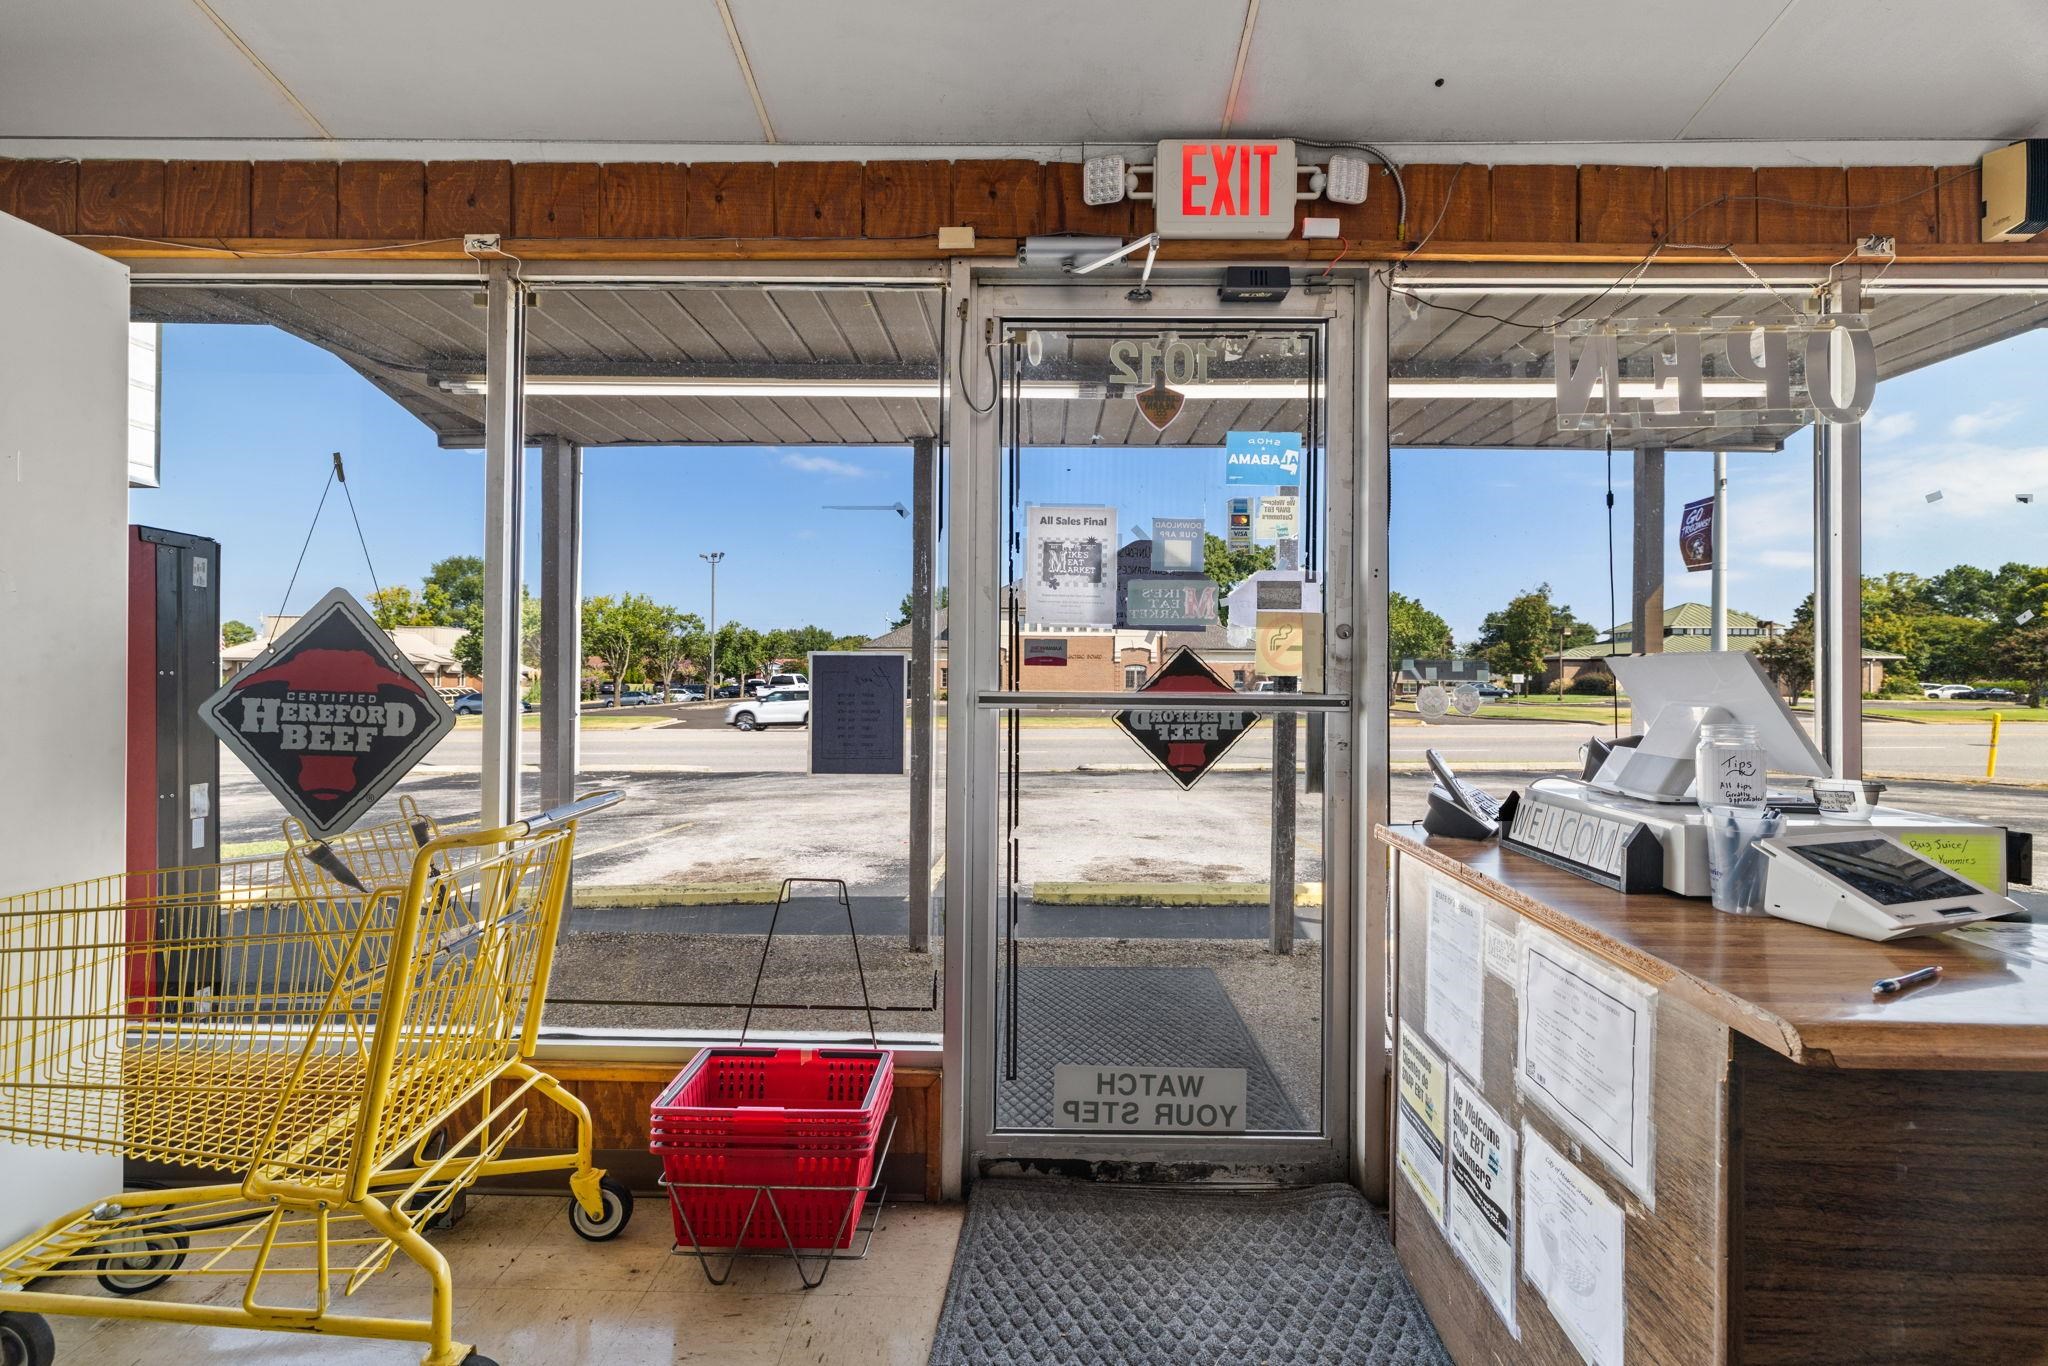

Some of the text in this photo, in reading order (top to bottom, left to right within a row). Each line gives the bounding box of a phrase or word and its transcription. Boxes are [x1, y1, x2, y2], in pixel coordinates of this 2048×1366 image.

[1181, 144, 1278, 216] EXIT
[1040, 516, 1107, 526] All Sales Final
[1686, 508, 1704, 525] GO
[286, 691, 377, 704] CERTIFIED
[240, 697, 416, 737] HEREFORD
[280, 724, 378, 753] BEEF
[1721, 755, 1753, 769] Tips
[1909, 839, 1969, 853] Bug Juice/
[1937, 854, 1976, 865] Yummies
[1414, 1082, 1424, 1104] EBT
[1453, 1086, 1463, 1112] We
[1465, 1097, 1501, 1151] Welcome
[1470, 1125, 1486, 1158] EBT
[1452, 1130, 1492, 1191] Customers
